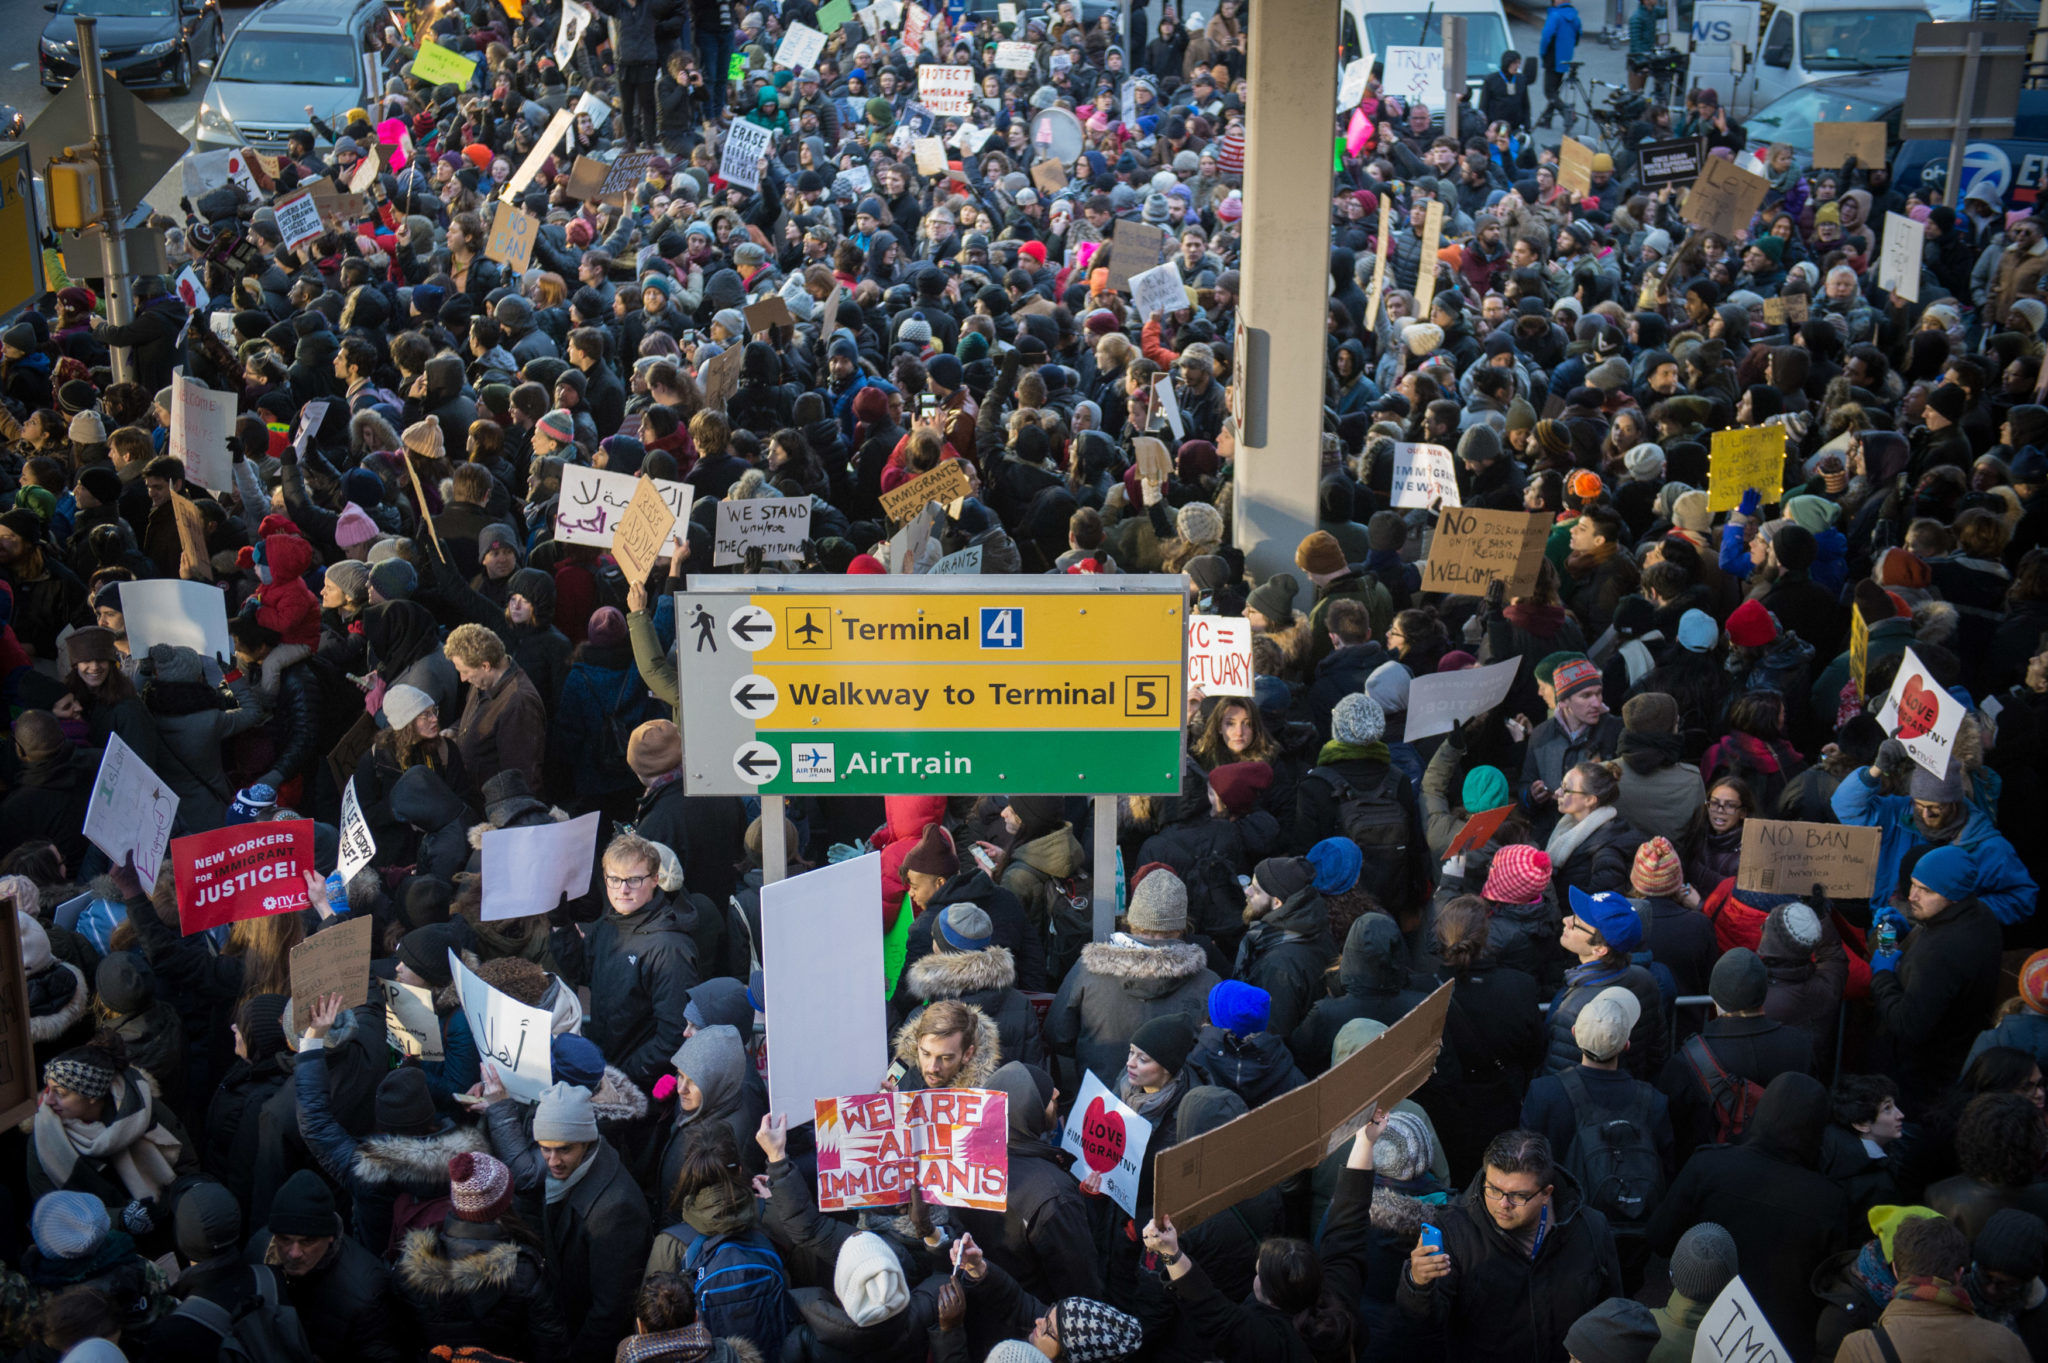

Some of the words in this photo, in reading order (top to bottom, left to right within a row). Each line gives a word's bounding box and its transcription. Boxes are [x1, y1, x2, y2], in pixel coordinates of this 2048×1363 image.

[1392, 50, 1442, 70] TRUM
[732, 125, 767, 149] ERASE
[507, 211, 527, 235] NO
[494, 231, 527, 261] BAN
[881, 462, 960, 509] IMMIGRANTS
[892, 501, 916, 517] MAKE
[920, 478, 958, 502] AMERICA
[1395, 481, 1428, 492] NEW
[727, 505, 752, 522] WE
[761, 503, 808, 520] STAND
[1442, 510, 1477, 535] NO
[717, 539, 736, 553] THE
[1430, 559, 1501, 585] WELCOME
[842, 616, 970, 640] Terminal
[987, 611, 1019, 646] 4
[1189, 621, 1210, 648] YC
[1189, 652, 1252, 689] CTUARY
[789, 682, 929, 711] Walkway
[943, 684, 975, 706] to
[989, 682, 1115, 706] Terminal
[1136, 682, 1157, 710] 5
[1906, 693, 1935, 722] LOVE
[846, 751, 972, 774] AirTrain
[194, 851, 225, 870] NEW
[228, 833, 294, 857] YORKERS
[1760, 825, 1794, 847] NO
[1806, 829, 1850, 849] BAN
[195, 873, 212, 884] FOR
[215, 847, 295, 878] IMMIGRANT
[1787, 869, 1829, 878] America
[195, 860, 297, 907] JUSTICE!
[840, 1098, 893, 1134] WE
[904, 1094, 983, 1128] ARE
[876, 1124, 951, 1163] ALL
[1089, 1121, 1123, 1148] LOVE
[1066, 1127, 1137, 1176] #IMMIGRANTNY
[819, 1159, 1007, 1200] IMMIGRANTS
